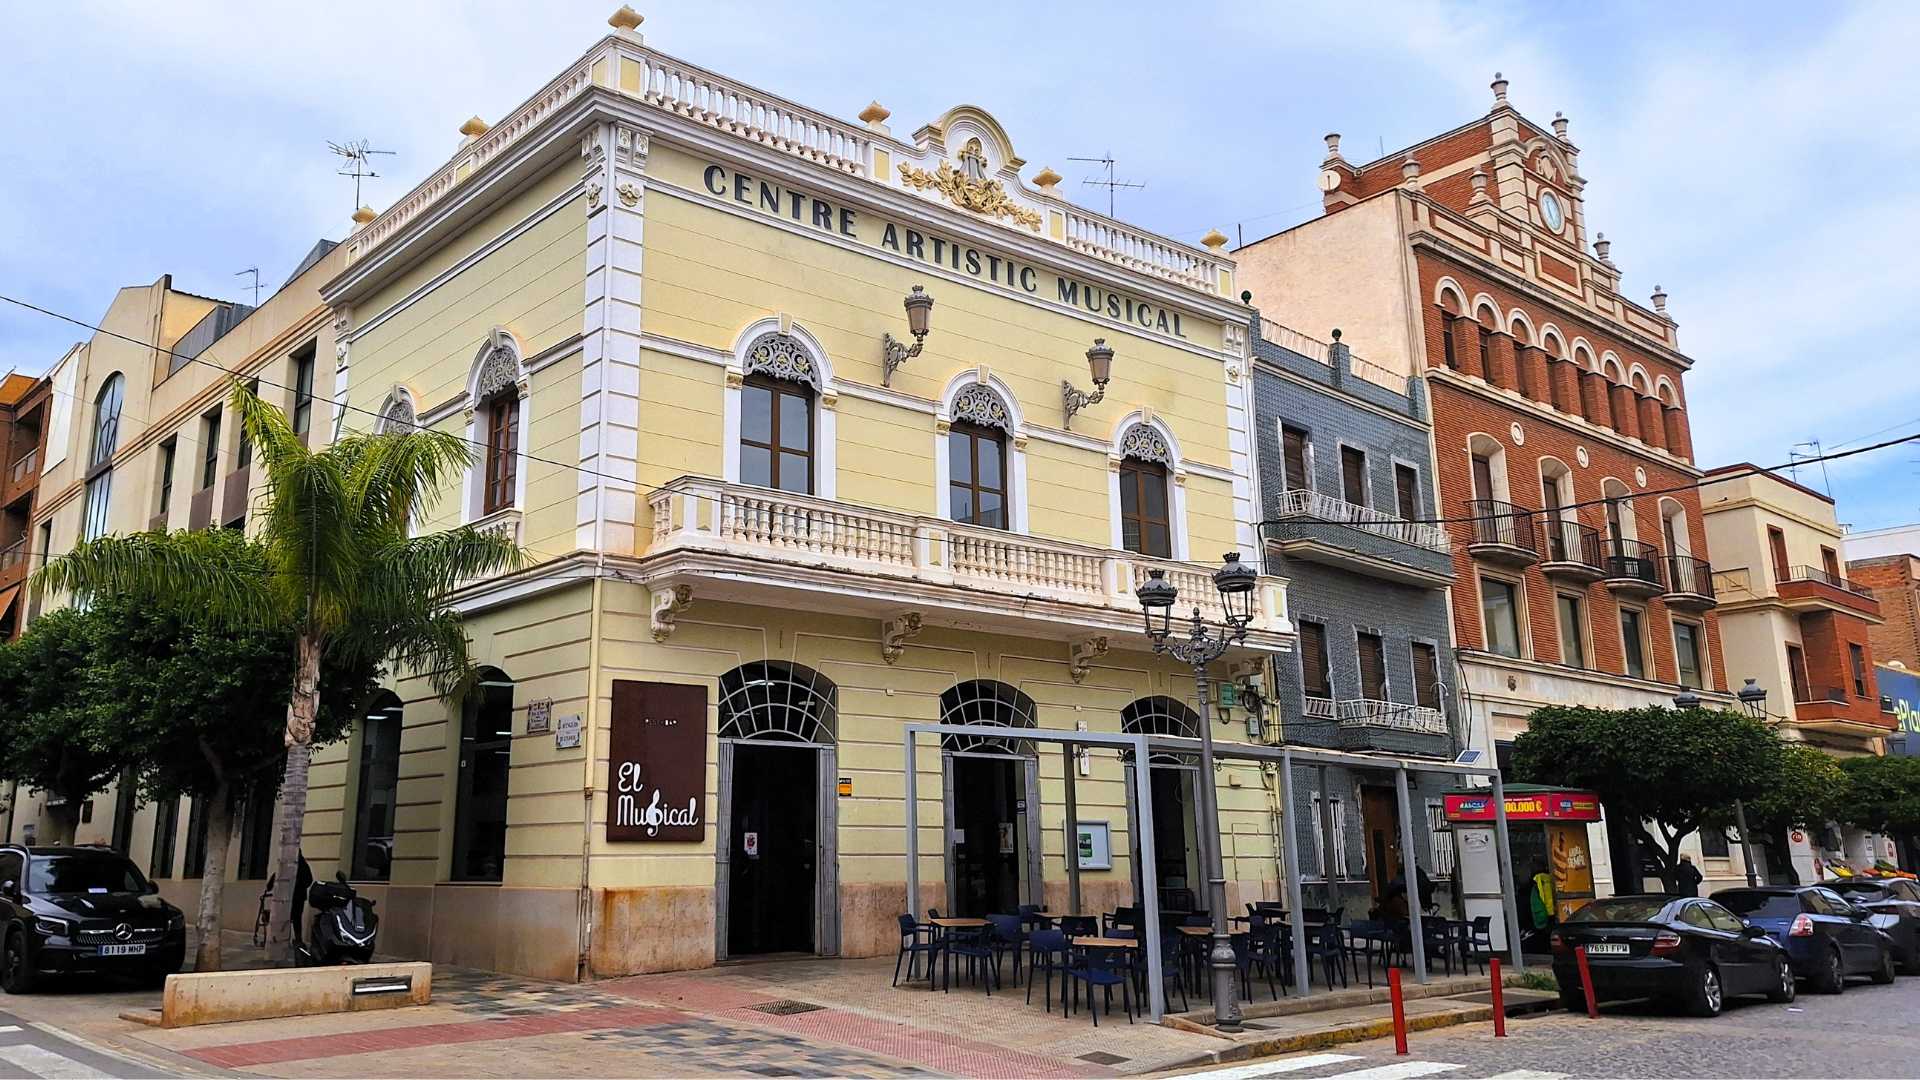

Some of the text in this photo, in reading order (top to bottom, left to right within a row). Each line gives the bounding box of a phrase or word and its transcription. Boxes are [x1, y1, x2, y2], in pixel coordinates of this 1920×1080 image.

[703, 165, 1187, 338] CENTRE ARTISTIC MUSICAL
[617, 761, 643, 792] El
